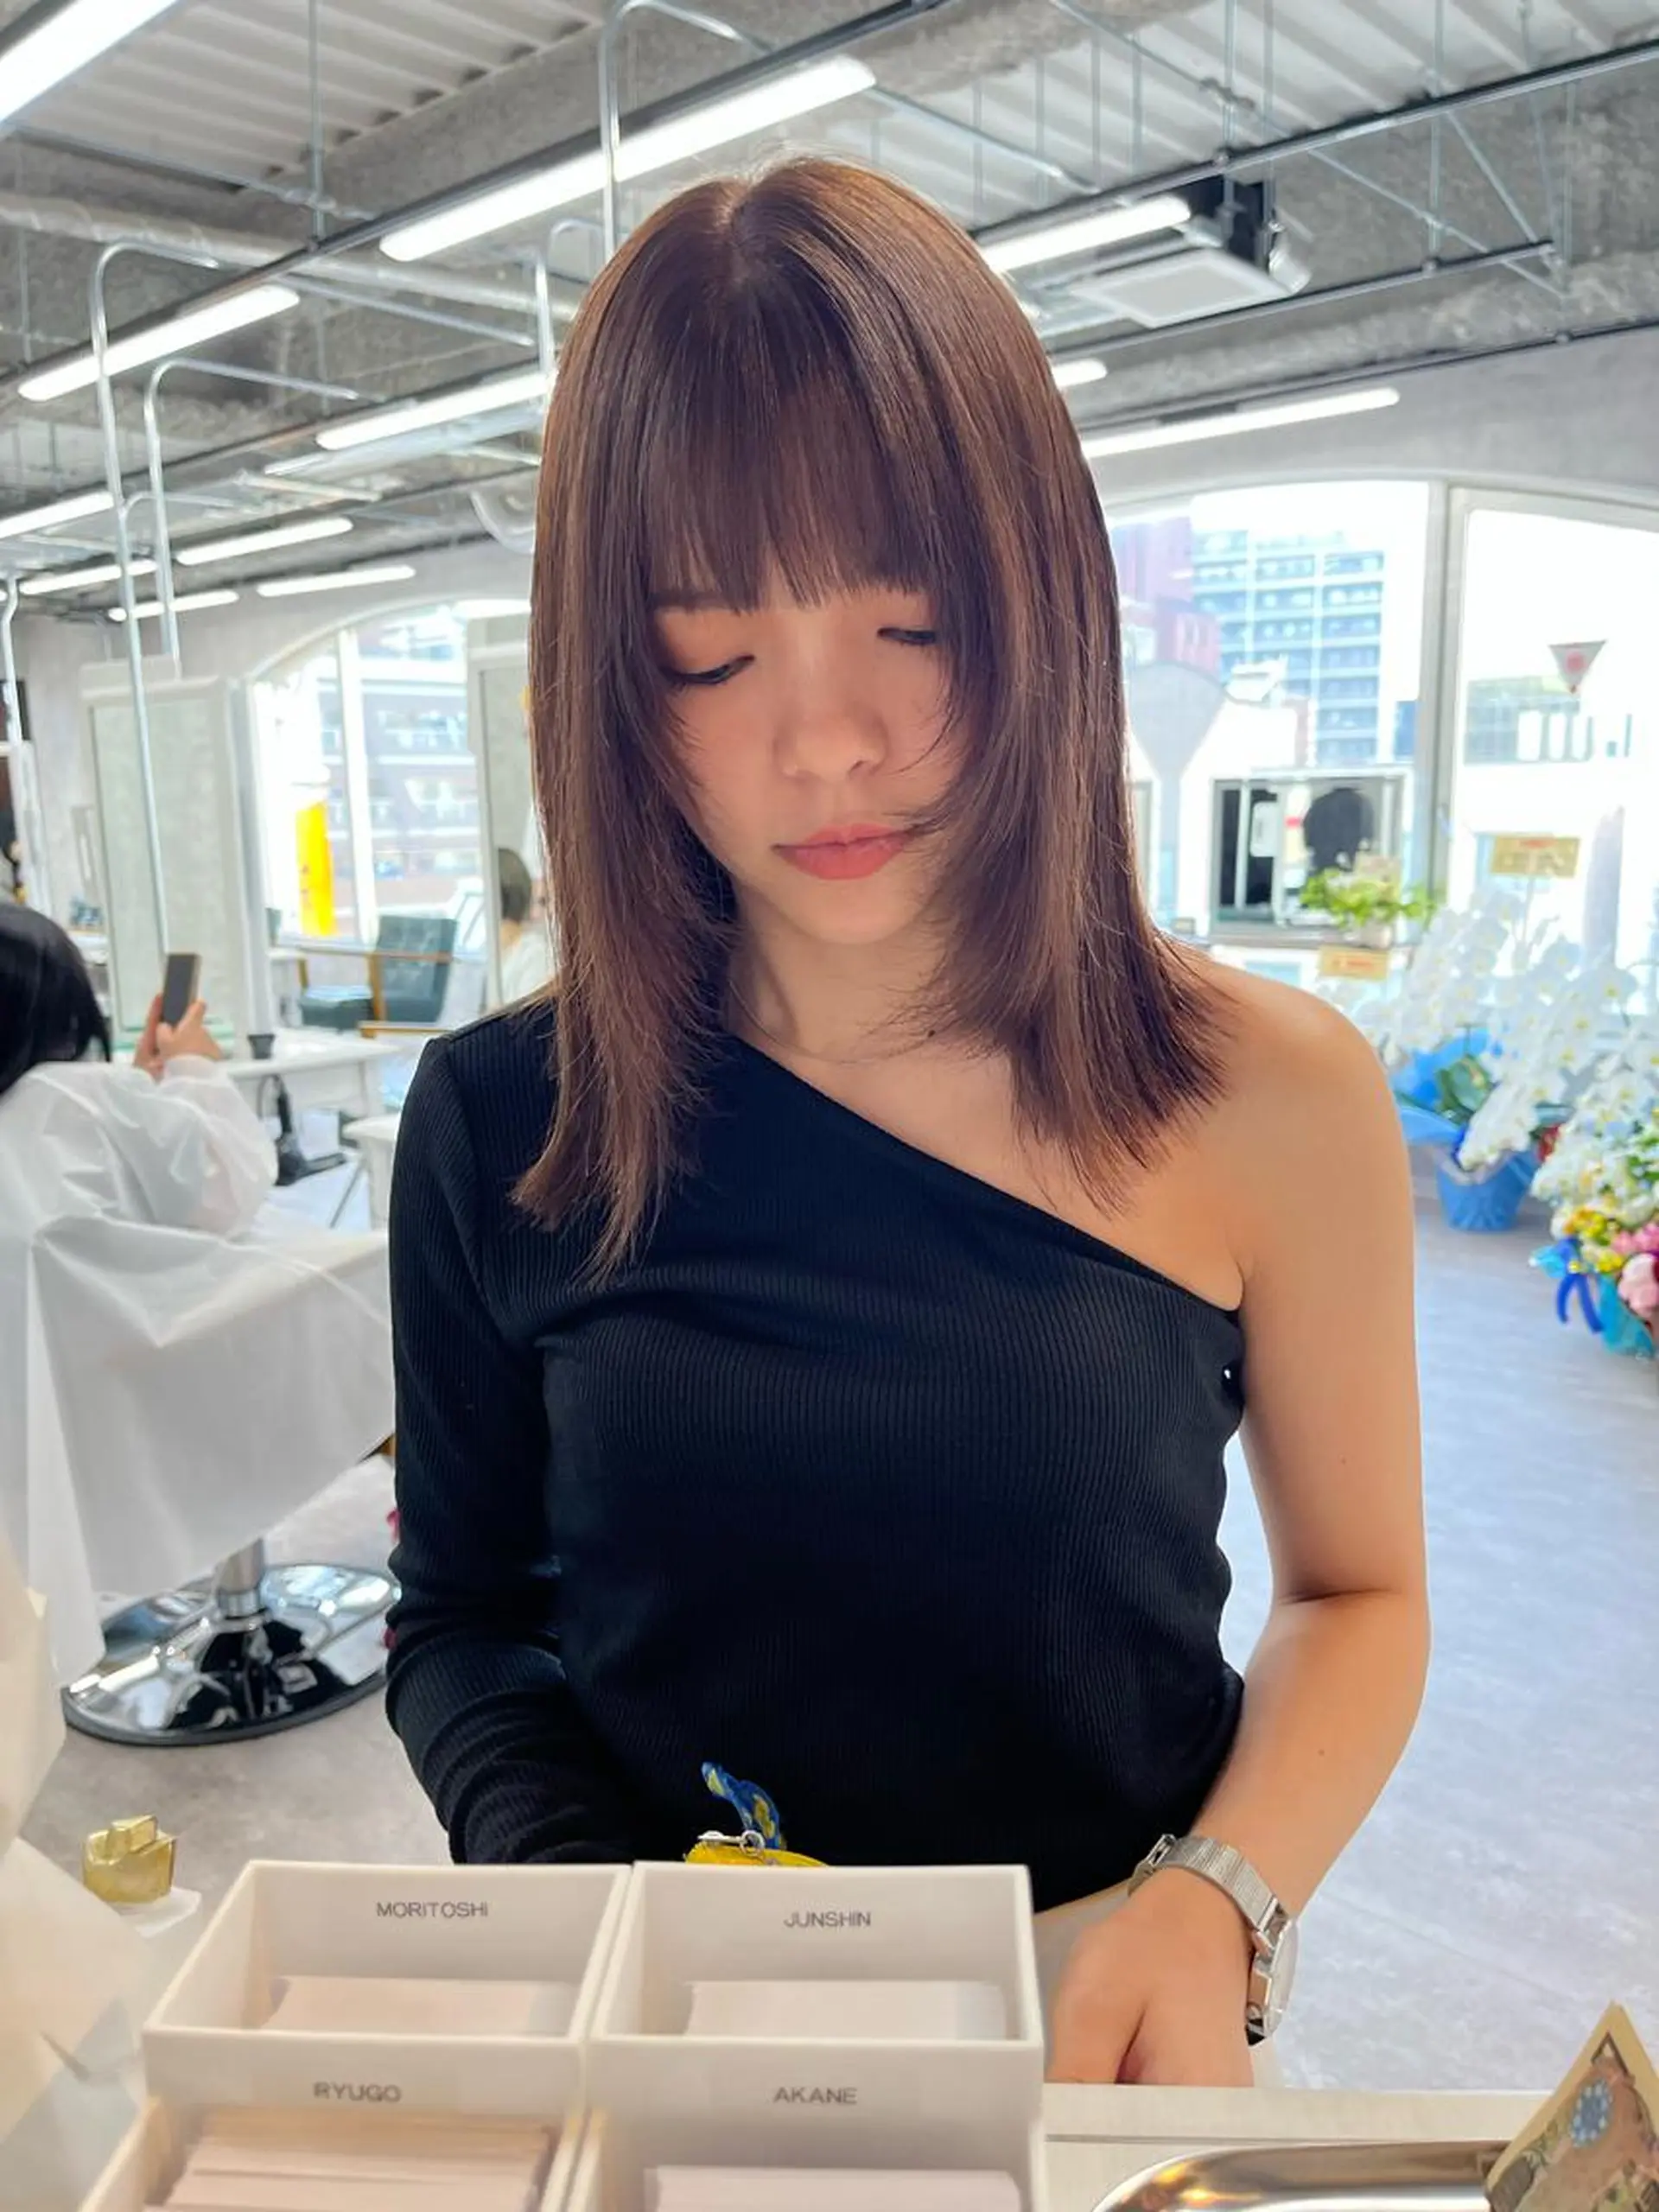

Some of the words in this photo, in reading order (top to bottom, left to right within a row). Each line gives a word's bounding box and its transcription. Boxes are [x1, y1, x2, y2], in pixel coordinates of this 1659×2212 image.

[377, 1901, 488, 1918] MORITOSHI
[784, 1910, 872, 1928] JUNSHIN
[315, 2082, 402, 2102] RYUGO
[773, 2087, 857, 2105] AKANE
